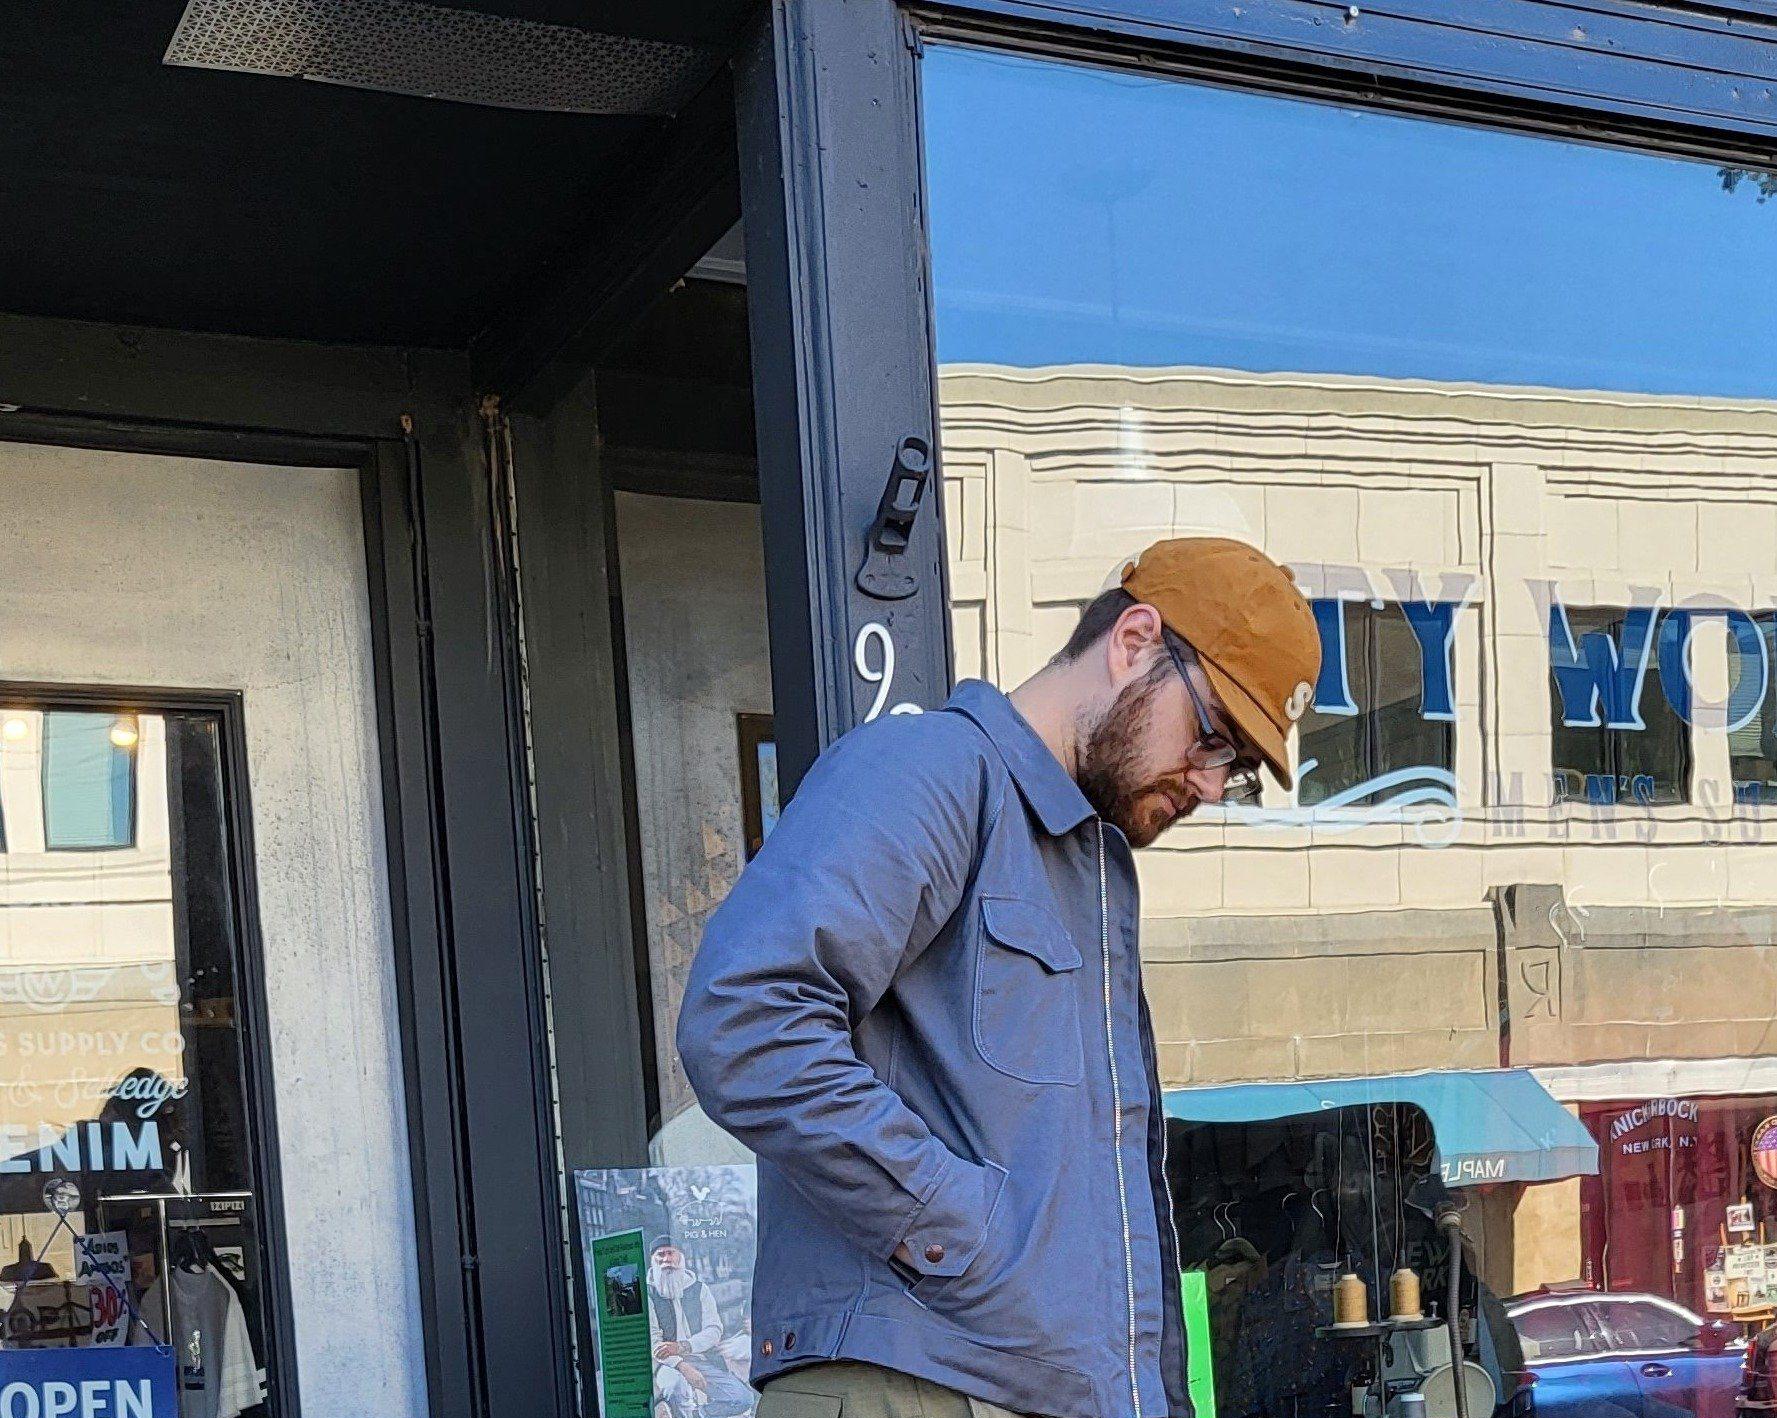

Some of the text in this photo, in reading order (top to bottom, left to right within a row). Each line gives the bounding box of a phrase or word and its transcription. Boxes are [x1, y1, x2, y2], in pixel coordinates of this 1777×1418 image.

[1284, 562, 1777, 733] TY WO
[19, 1030, 129, 1056] SUPPLY
[0, 1121, 164, 1174] ENIM
[684, 1230, 699, 1239] PIG
[709, 1229, 727, 1238] HEN
